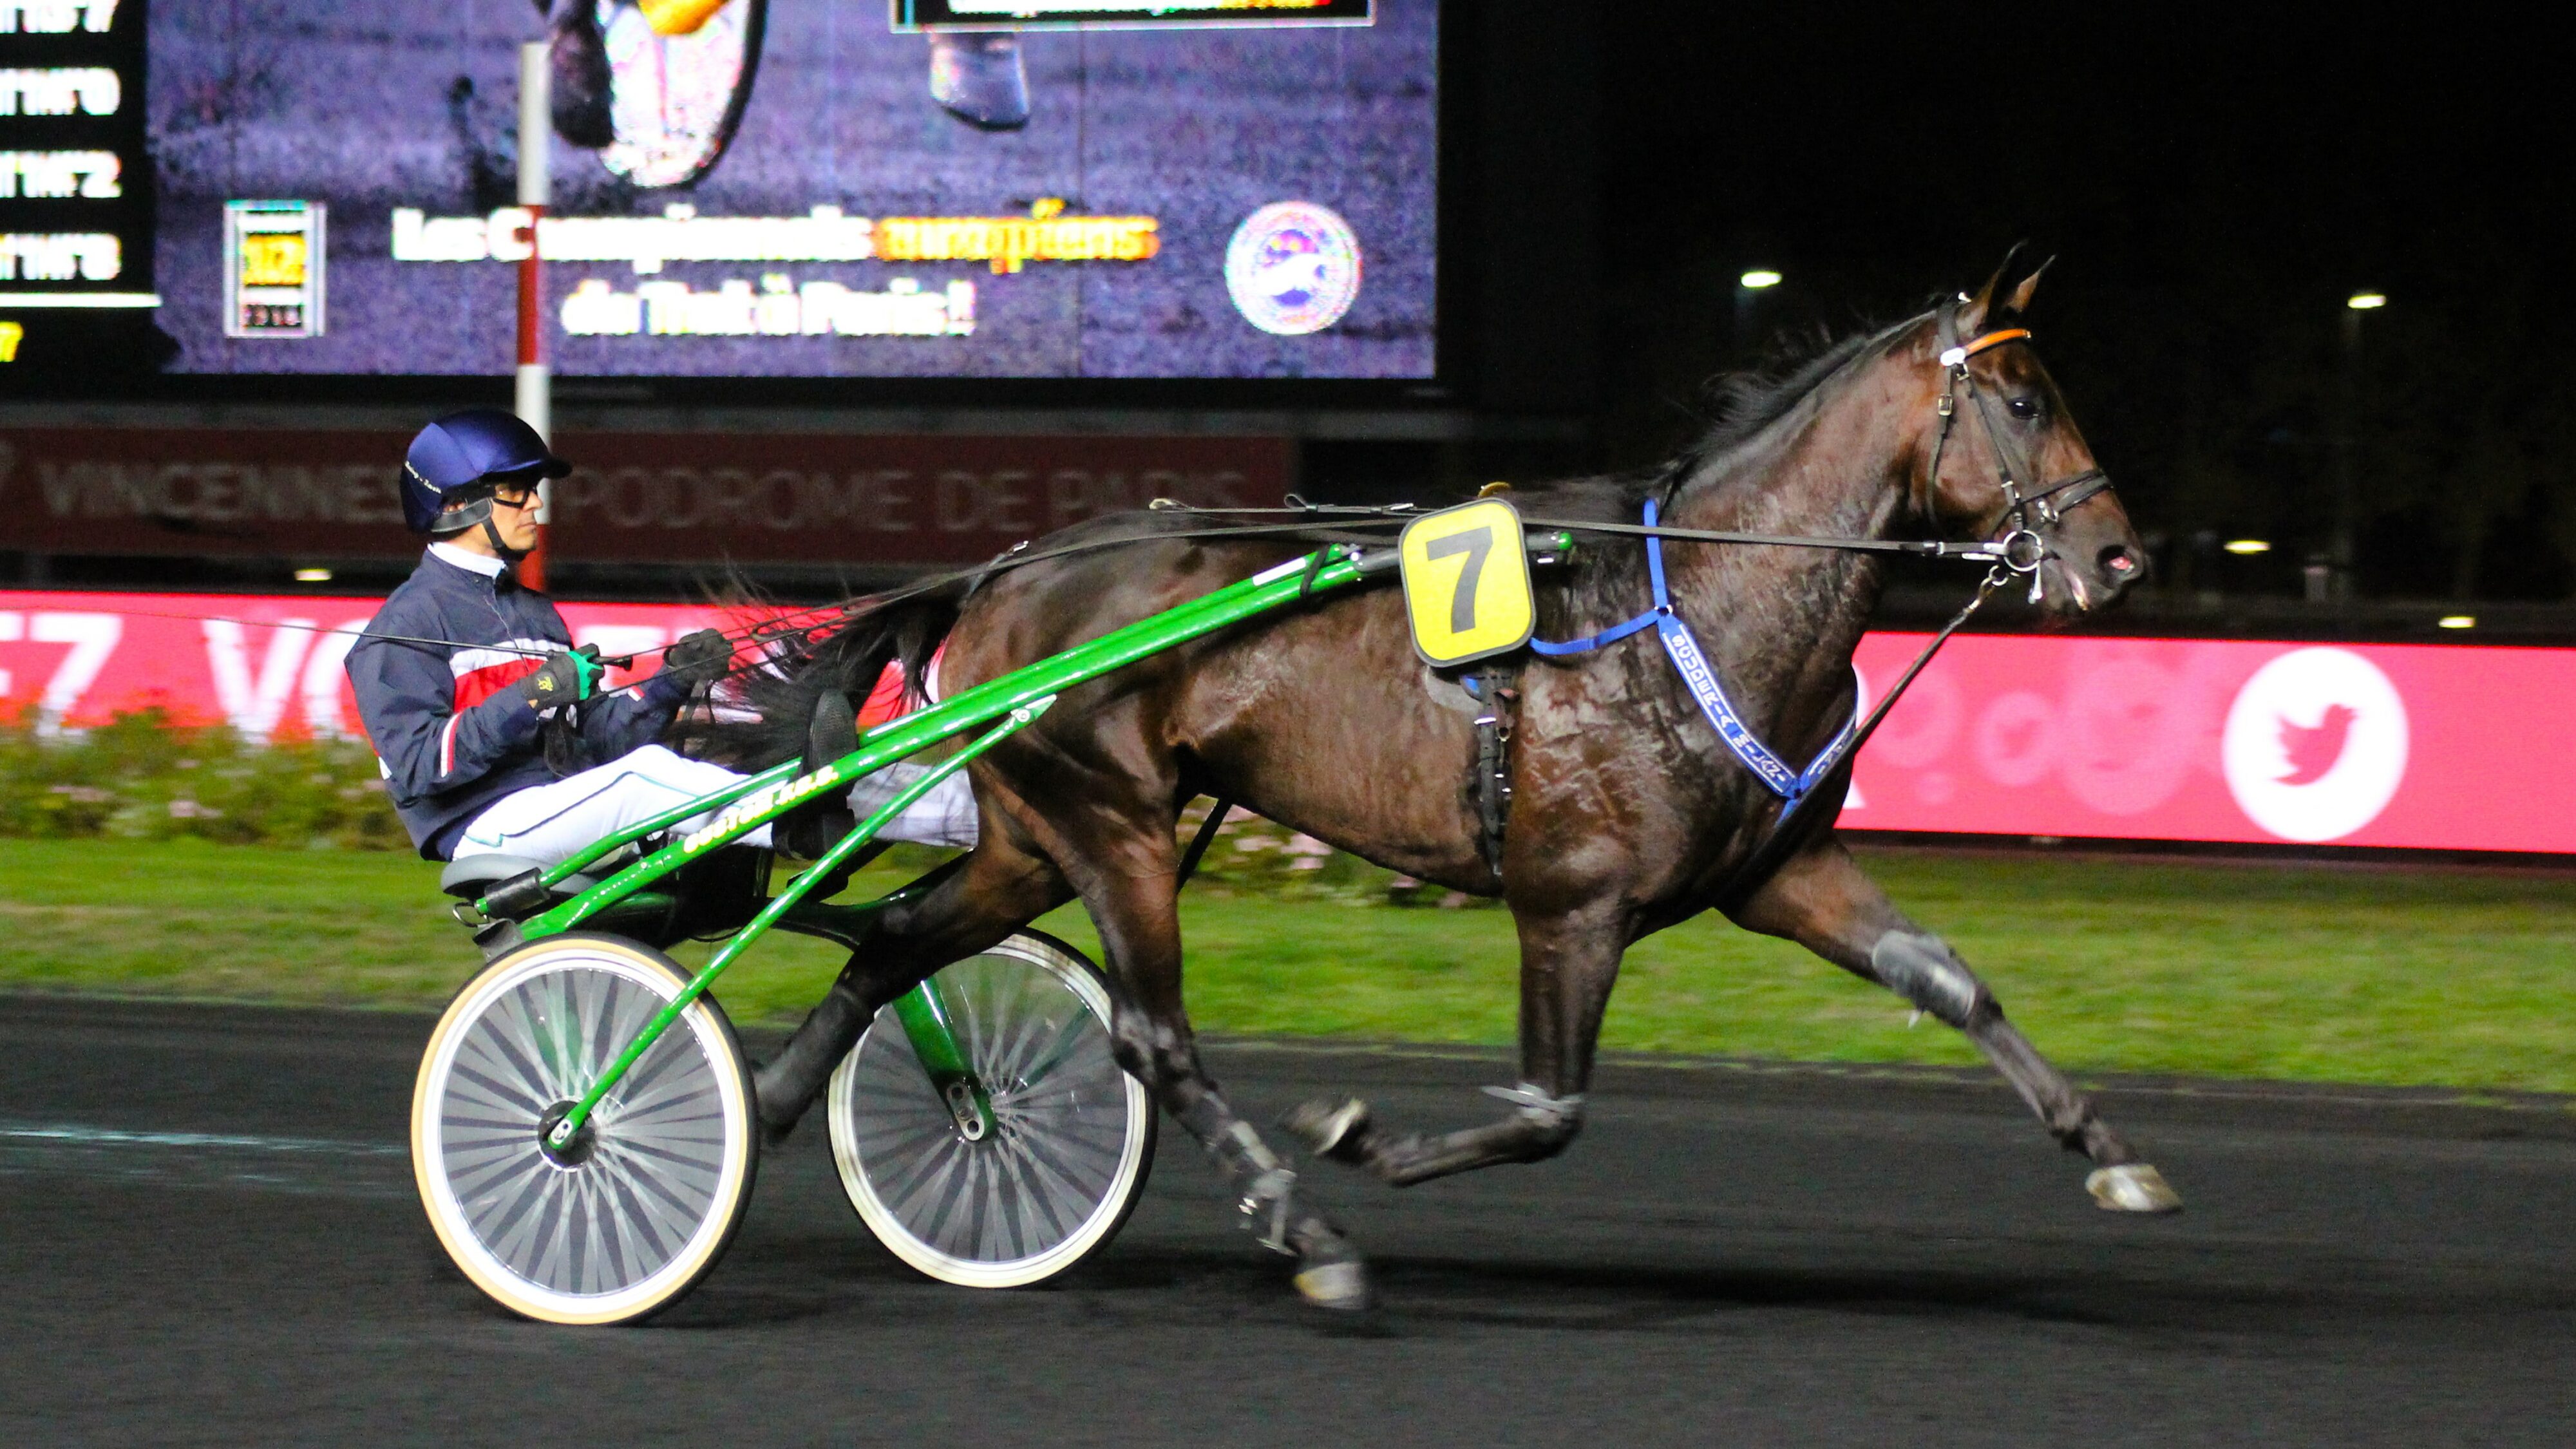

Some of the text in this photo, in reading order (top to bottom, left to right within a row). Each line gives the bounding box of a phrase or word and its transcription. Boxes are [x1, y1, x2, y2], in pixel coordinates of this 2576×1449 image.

[558, 466, 916, 532] PODROME
[934, 468, 1033, 533] DE
[1425, 526, 1493, 634] 7
[1672, 634, 1734, 728] SCUDERIA
